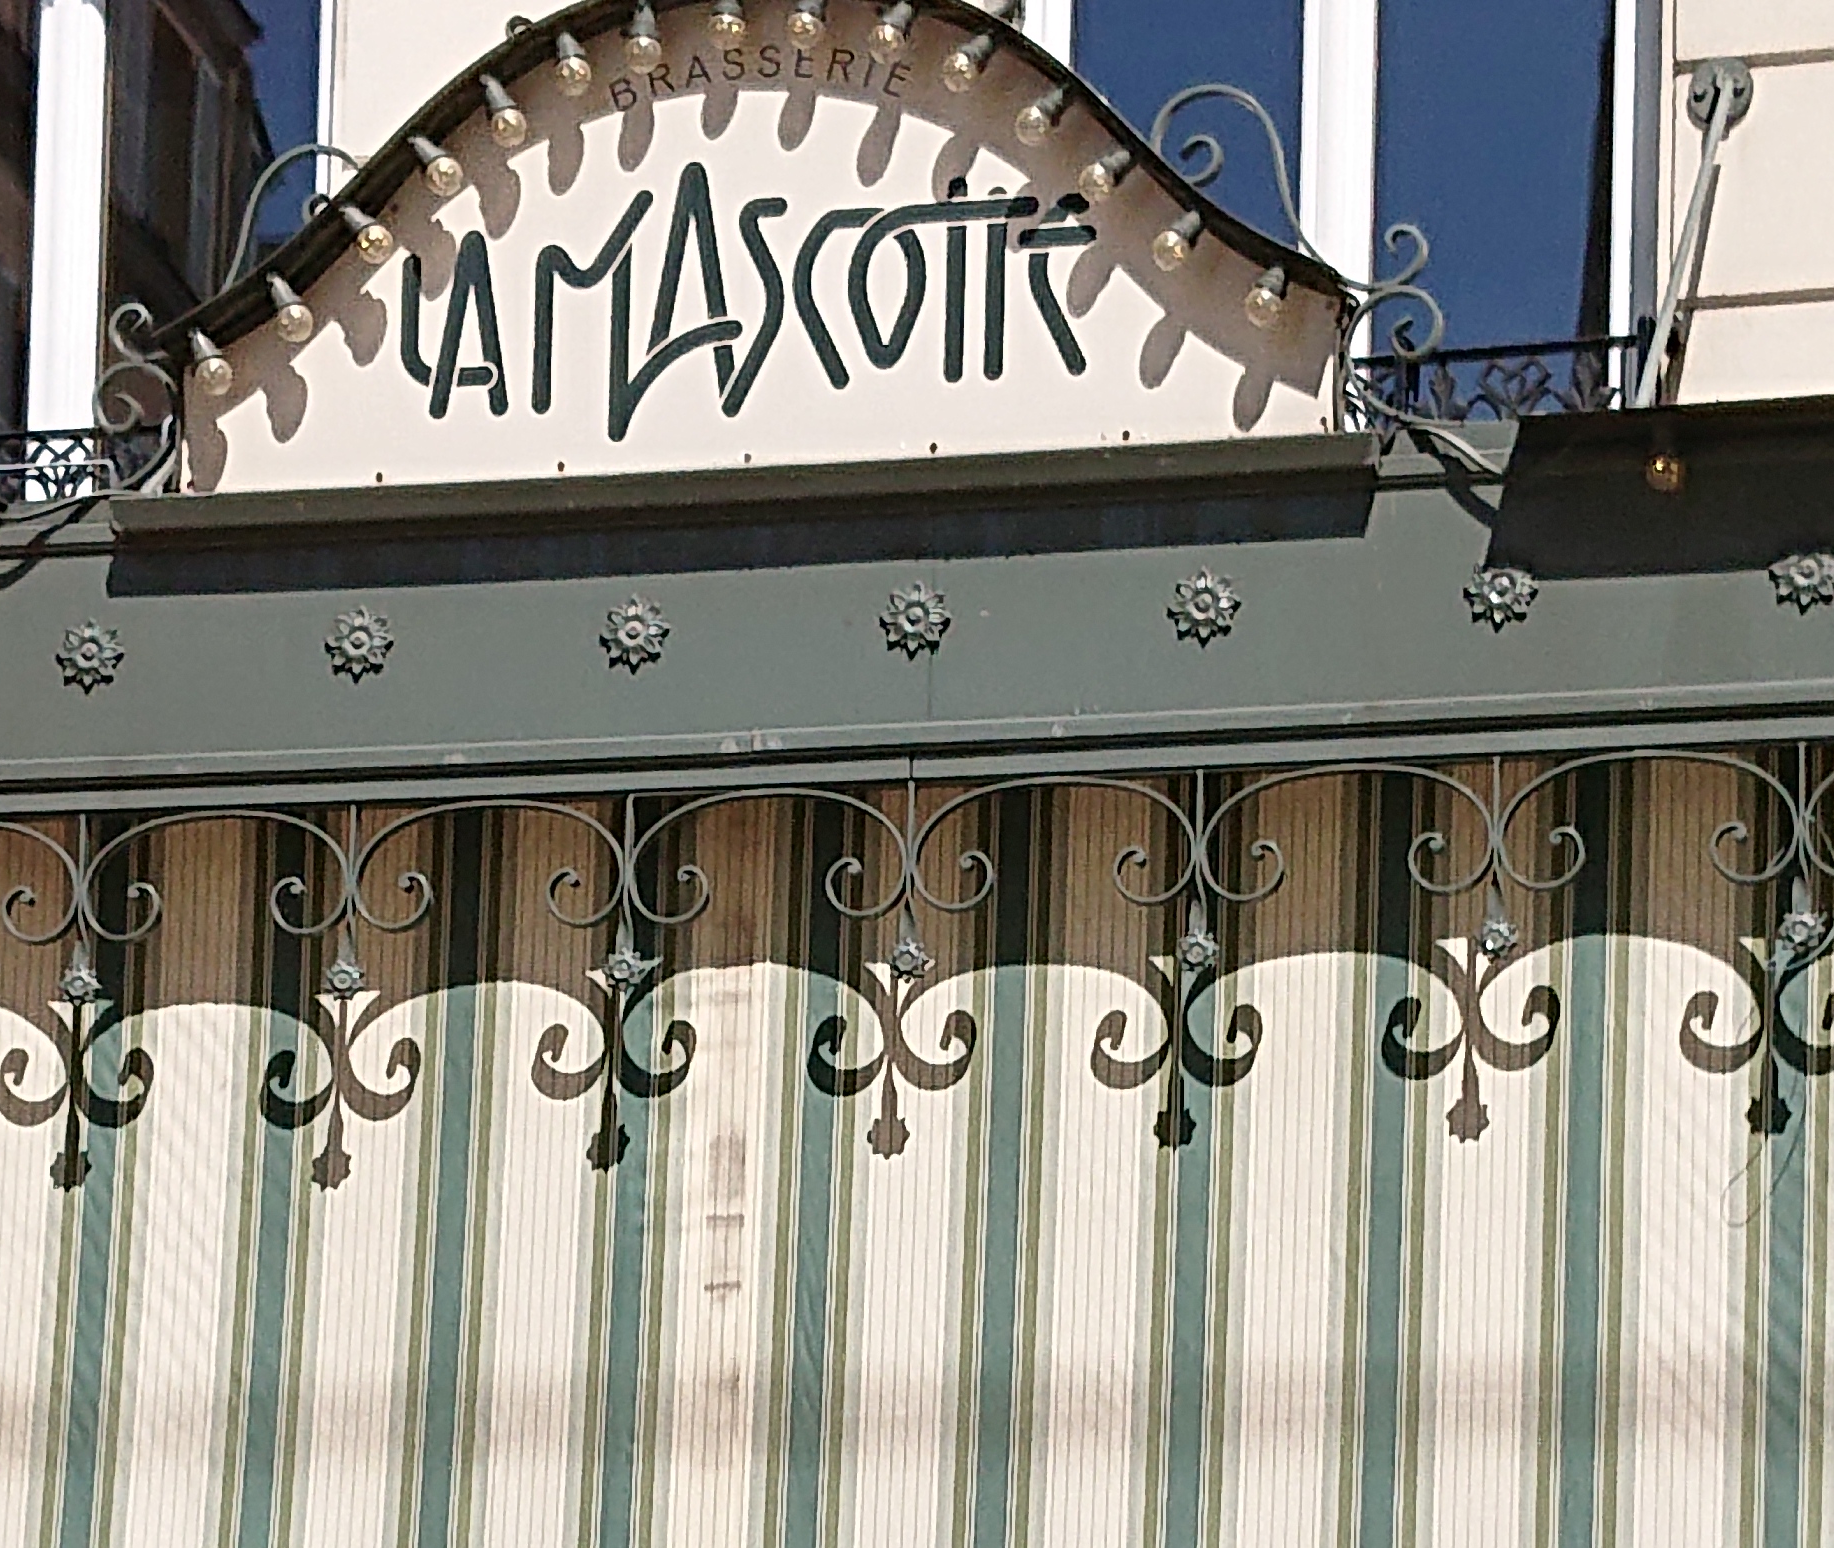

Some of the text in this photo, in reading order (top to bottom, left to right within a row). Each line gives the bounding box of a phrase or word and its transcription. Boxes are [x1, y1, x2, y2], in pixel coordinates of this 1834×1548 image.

[609, 45, 912, 112] BRASSERIE
[401, 161, 1097, 442] LA MASCOTTE
